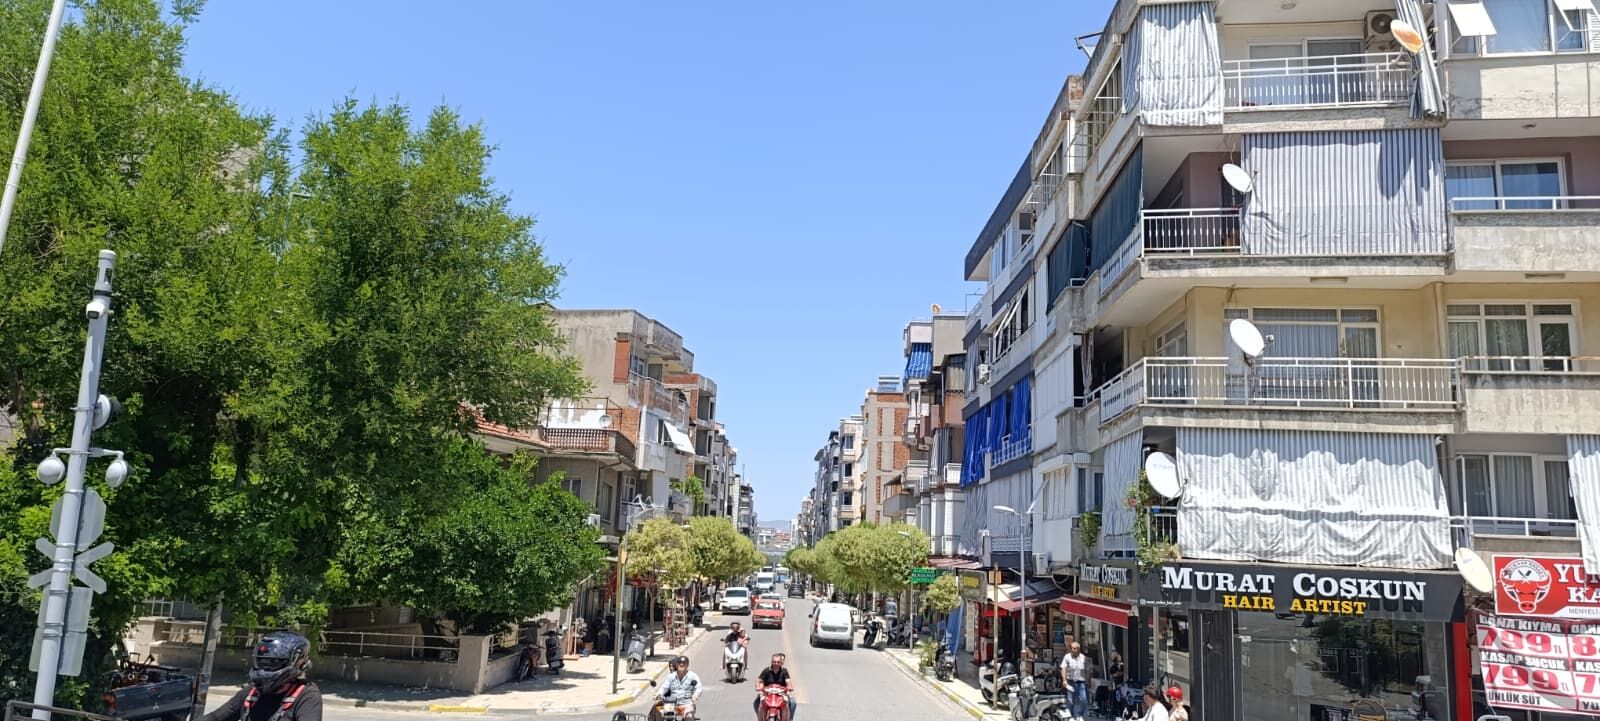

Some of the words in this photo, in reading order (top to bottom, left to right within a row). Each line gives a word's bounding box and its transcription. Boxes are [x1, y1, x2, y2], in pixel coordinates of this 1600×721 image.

[1161, 566, 1275, 594] MURAT
[1293, 573, 1426, 601] COŞKUN
[1223, 595, 1276, 610] HAIR
[1290, 598, 1367, 615] ARTIST
[1479, 614, 1516, 630] DANA
[1518, 619, 1562, 633] KIYMA
[1477, 625, 1552, 654] 799
[1572, 635, 1600, 656] 8
[1481, 651, 1524, 665] KASAP
[1525, 656, 1567, 670] SUCUK
[1480, 664, 1559, 691] 799
[1575, 673, 1600, 693] 7
[1521, 693, 1541, 706] SÜT
